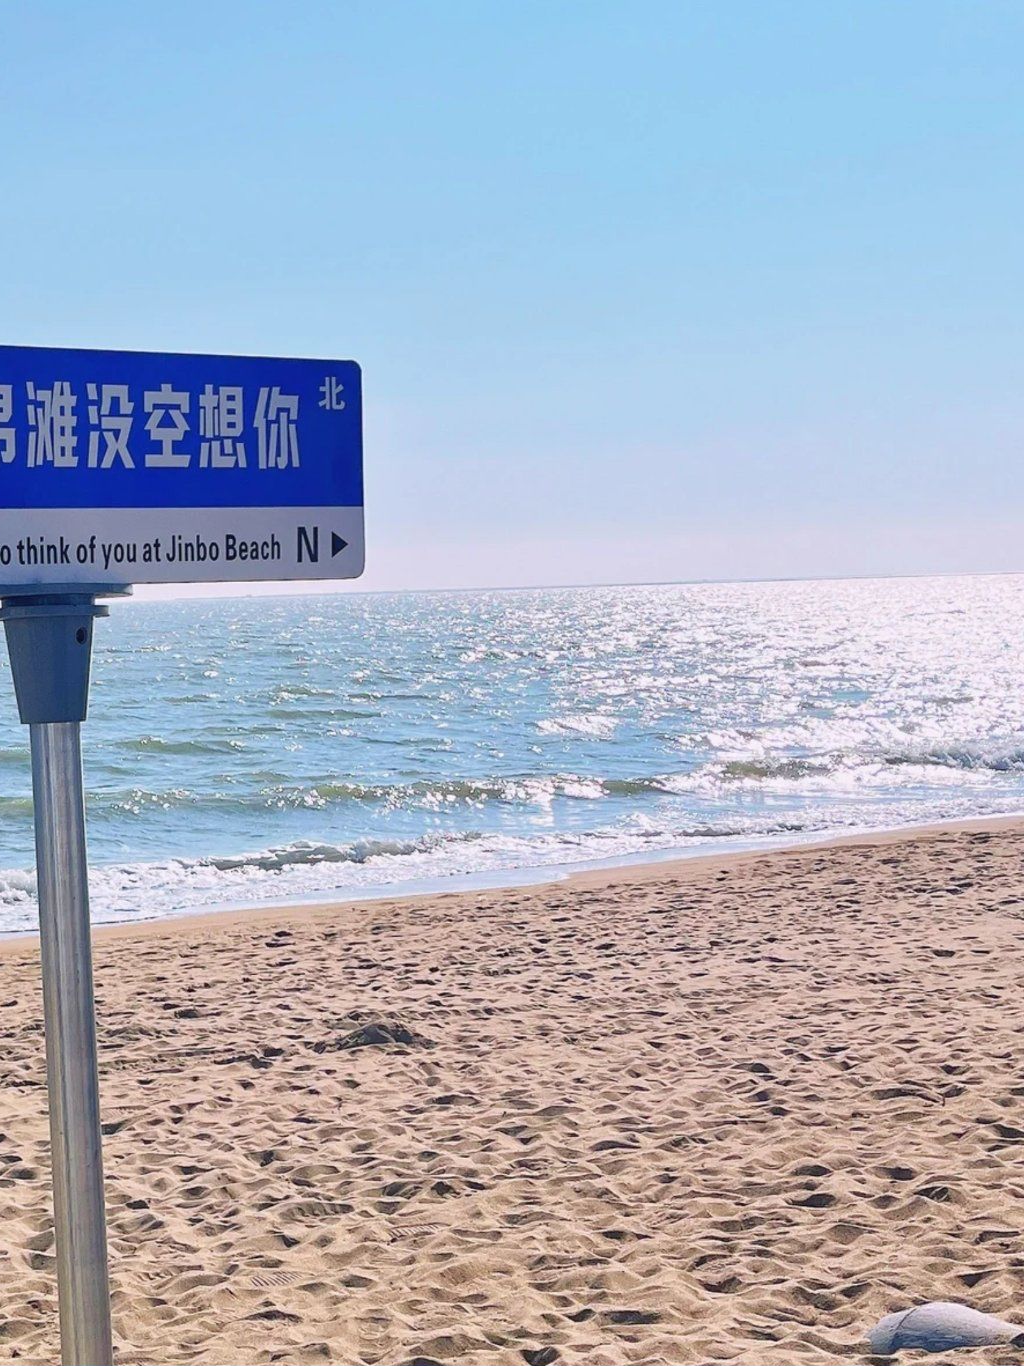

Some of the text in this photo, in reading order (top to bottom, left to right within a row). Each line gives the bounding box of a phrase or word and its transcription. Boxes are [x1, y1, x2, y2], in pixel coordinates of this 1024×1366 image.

[318, 376, 346, 411] 北
[16, 535, 72, 566] think
[75, 535, 98, 565] of
[100, 542, 138, 571] you
[141, 537, 163, 564] at
[165, 534, 221, 563] Jinbo
[225, 532, 282, 562] Beach
[295, 525, 320, 564] N
